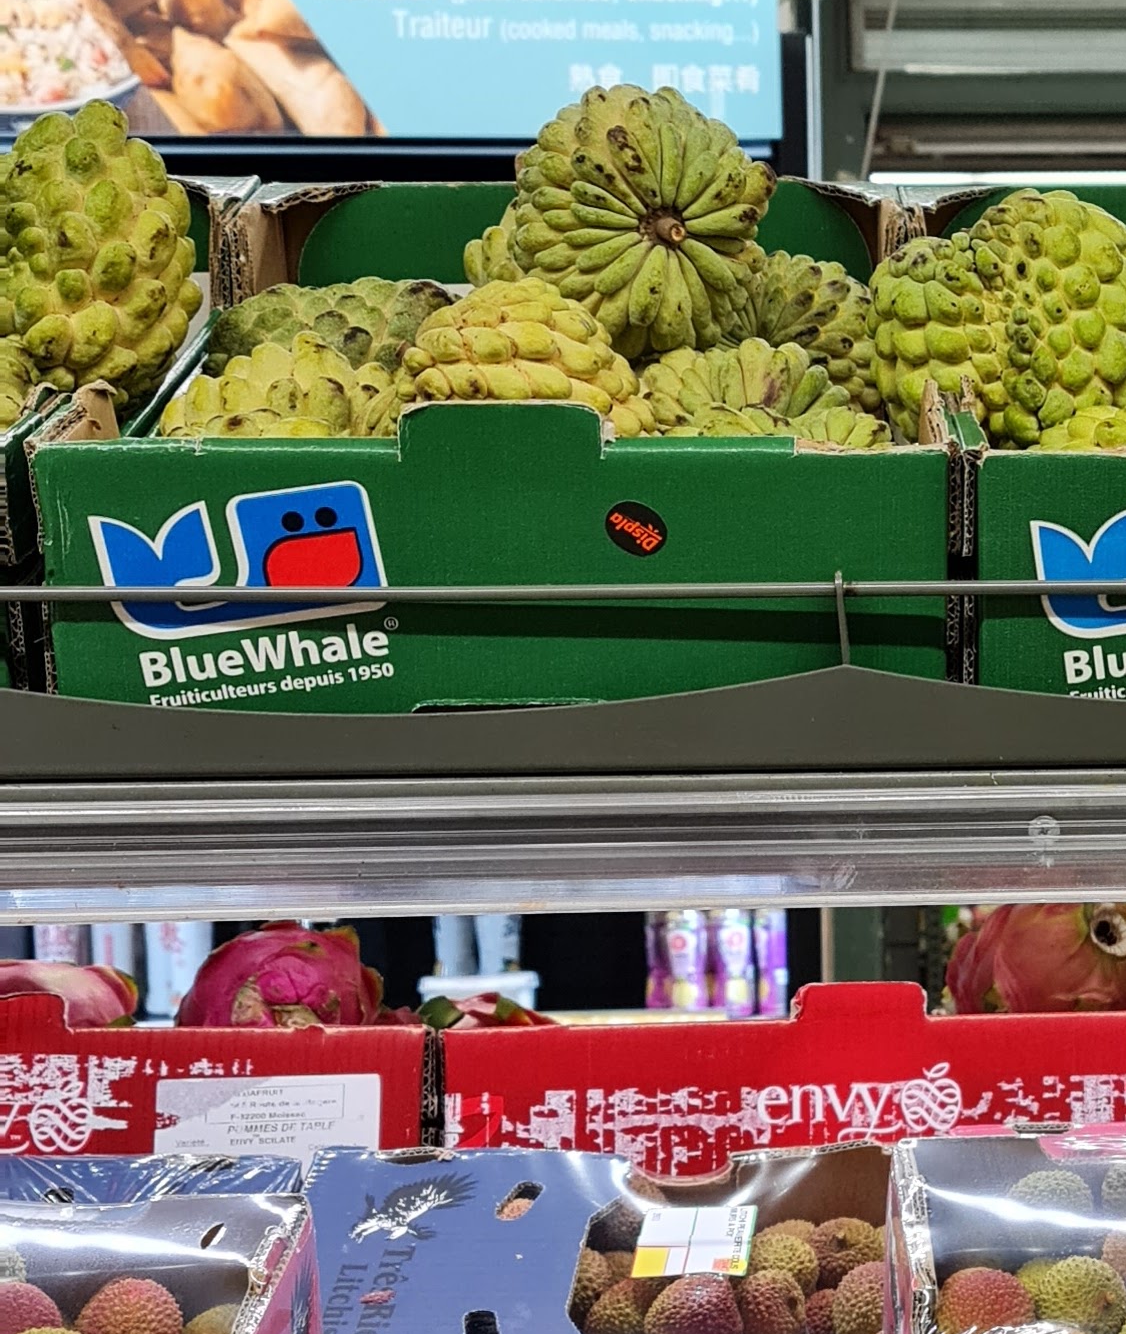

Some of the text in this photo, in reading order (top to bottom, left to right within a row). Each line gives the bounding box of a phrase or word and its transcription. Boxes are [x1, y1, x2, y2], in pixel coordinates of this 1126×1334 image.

[393, 9, 493, 40] Traiteur
[500, 19, 577, 42] (cooked
[583, 19, 643, 42] meals,
[282, 668, 345, 697] depuis
[347, 662, 395, 685] 1950
[757, 1081, 901, 1141] envy
[371, 1245, 416, 1293] Trê
